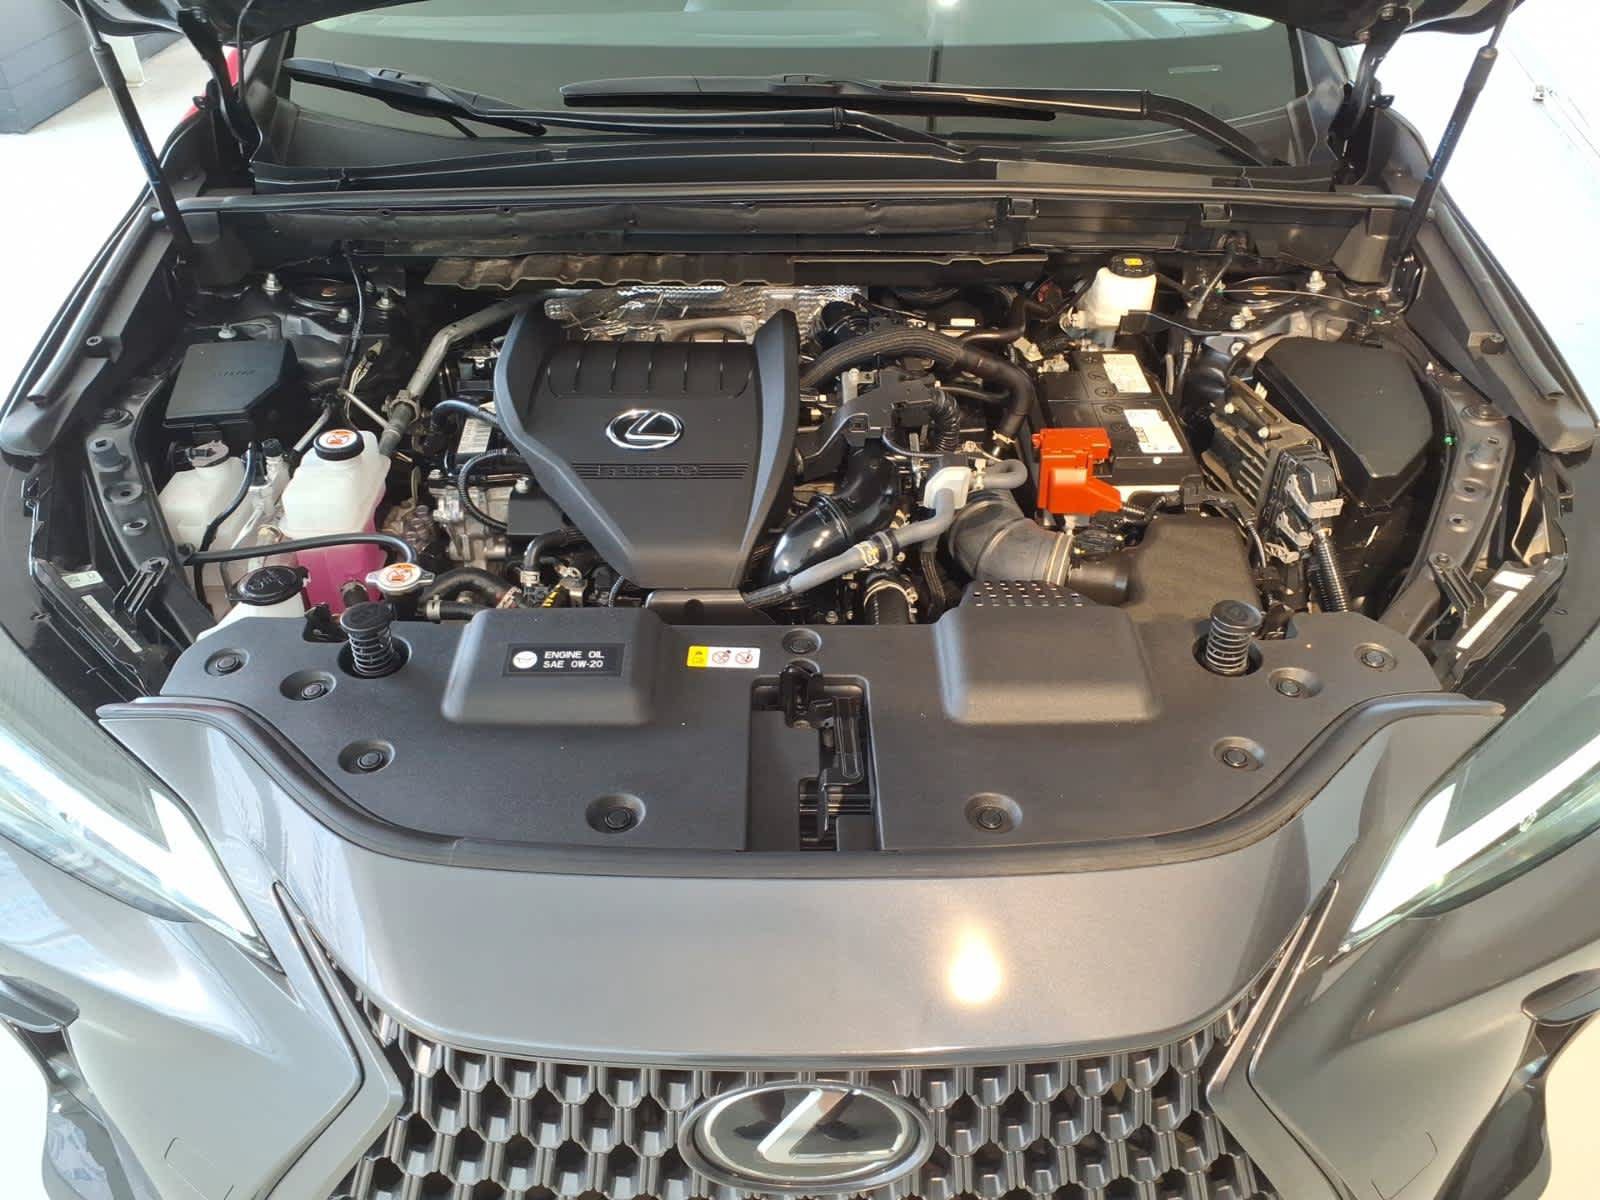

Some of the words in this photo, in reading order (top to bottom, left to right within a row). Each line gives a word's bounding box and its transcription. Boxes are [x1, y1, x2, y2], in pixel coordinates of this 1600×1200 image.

[544, 650, 583, 659] ENGINE
[587, 650, 605, 659] OIL
[543, 660, 565, 669] SAE
[570, 660, 604, 669] 0W-20
